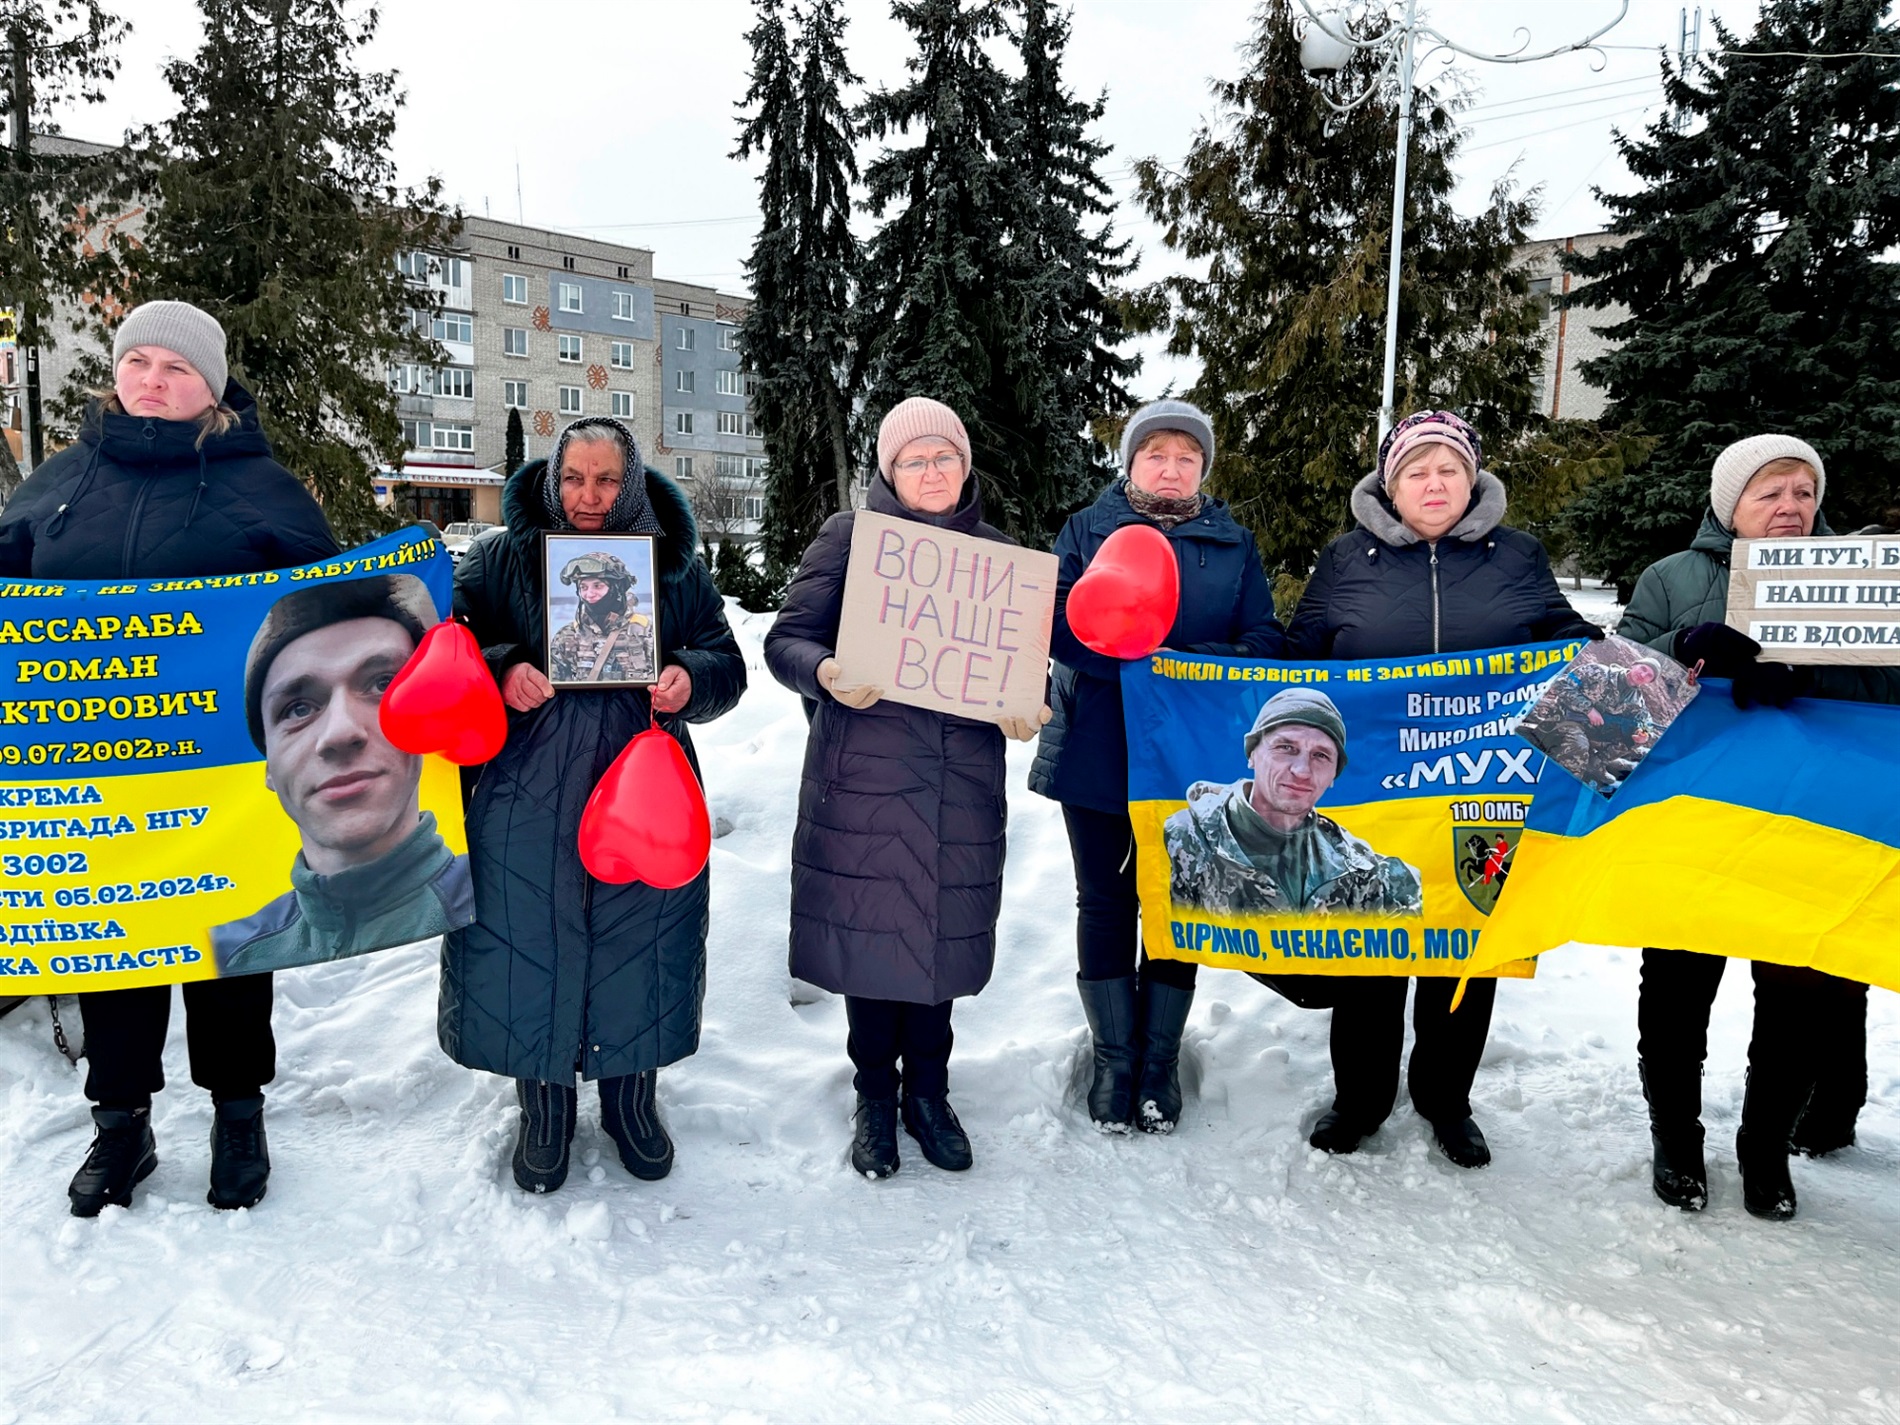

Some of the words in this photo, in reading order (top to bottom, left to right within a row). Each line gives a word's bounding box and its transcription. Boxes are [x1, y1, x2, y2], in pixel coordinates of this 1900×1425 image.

[0, 583, 67, 597] ЛИЙ
[97, 584, 138, 595] НЕ
[148, 572, 279, 592] ЗНАЧИТЬ
[290, 538, 436, 580] ЗАБУТИЙ!!!
[1758, 548, 1804, 566] МИ
[1811, 547, 1870, 568] ТУТ,
[1766, 585, 1849, 604] НАШІ
[0, 611, 203, 644] АССАРАБА
[879, 585, 1023, 652] НАШЕ
[1758, 625, 1797, 643] НЕ
[1803, 625, 1900, 647] ВДОМА
[16, 655, 158, 683] РОМАН
[894, 637, 1013, 708] ВСЕ!
[1151, 656, 1223, 681] ЗНИКЛІ
[1227, 667, 1329, 683] БЕЗВІСТИ
[1347, 668, 1372, 682] НЕ
[1377, 658, 1471, 681] ЗАГИБЛІ
[1489, 653, 1515, 675] НЕ
[0, 690, 218, 724] КТОРОВИЧ
[1407, 692, 1481, 717] Вітюк
[1381, 748, 1547, 789] «МУХ
[146, 807, 209, 830] НГУ
[1451, 802, 1480, 821] 110
[3, 853, 88, 876] 3002
[1170, 921, 1267, 961] ВІРИМО,
[1270, 928, 1417, 962] ЧЕКАЄМО,
[50, 945, 201, 974] ОБЛАСТЬ
